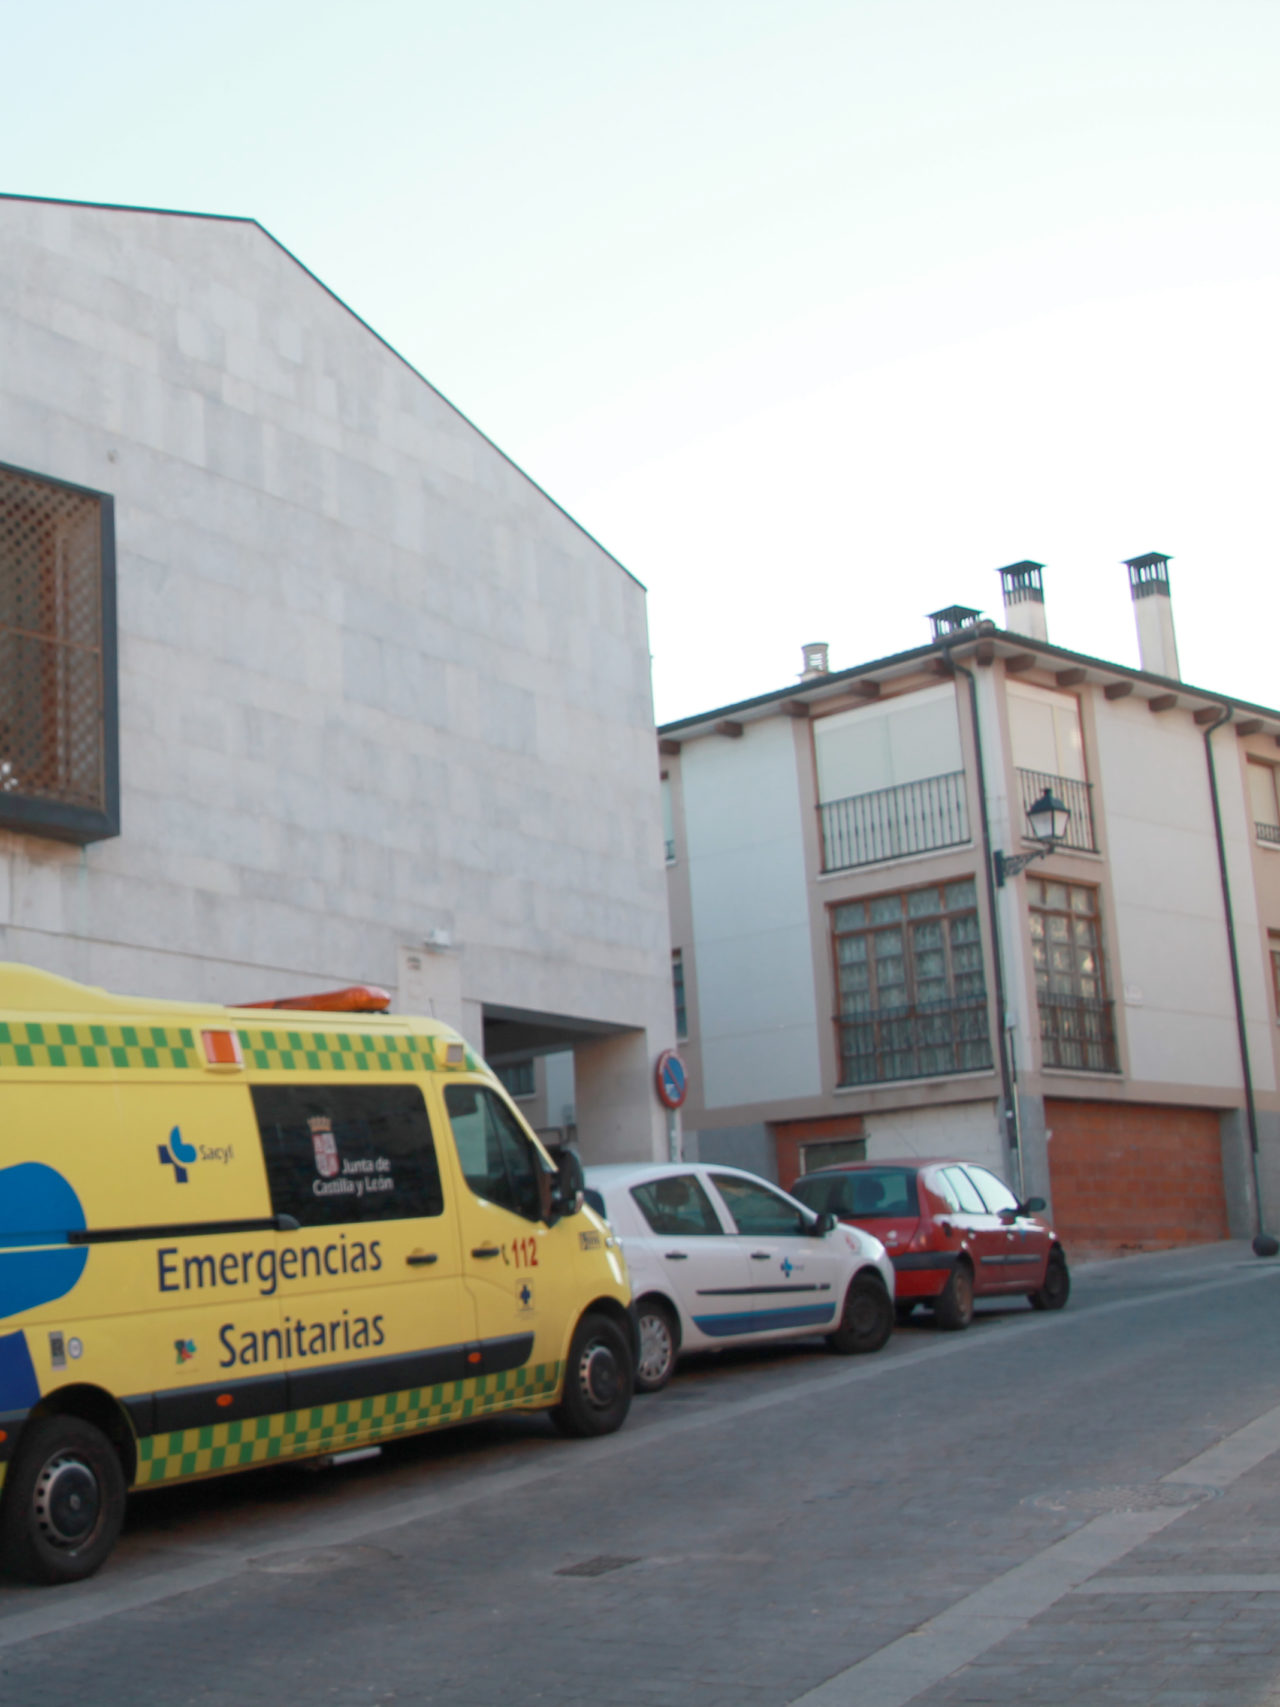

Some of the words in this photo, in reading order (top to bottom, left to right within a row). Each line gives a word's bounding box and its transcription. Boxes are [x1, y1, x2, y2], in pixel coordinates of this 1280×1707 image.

[199, 1144, 234, 1165] Sacyl
[342, 1158, 374, 1174] Junta
[375, 1156, 391, 1173] de
[312, 1178, 355, 1196] Castilla
[364, 1175, 394, 1192] León
[157, 1233, 382, 1295] Emergencias
[512, 1237, 539, 1269] 112
[219, 1309, 385, 1369] Sanitarias
